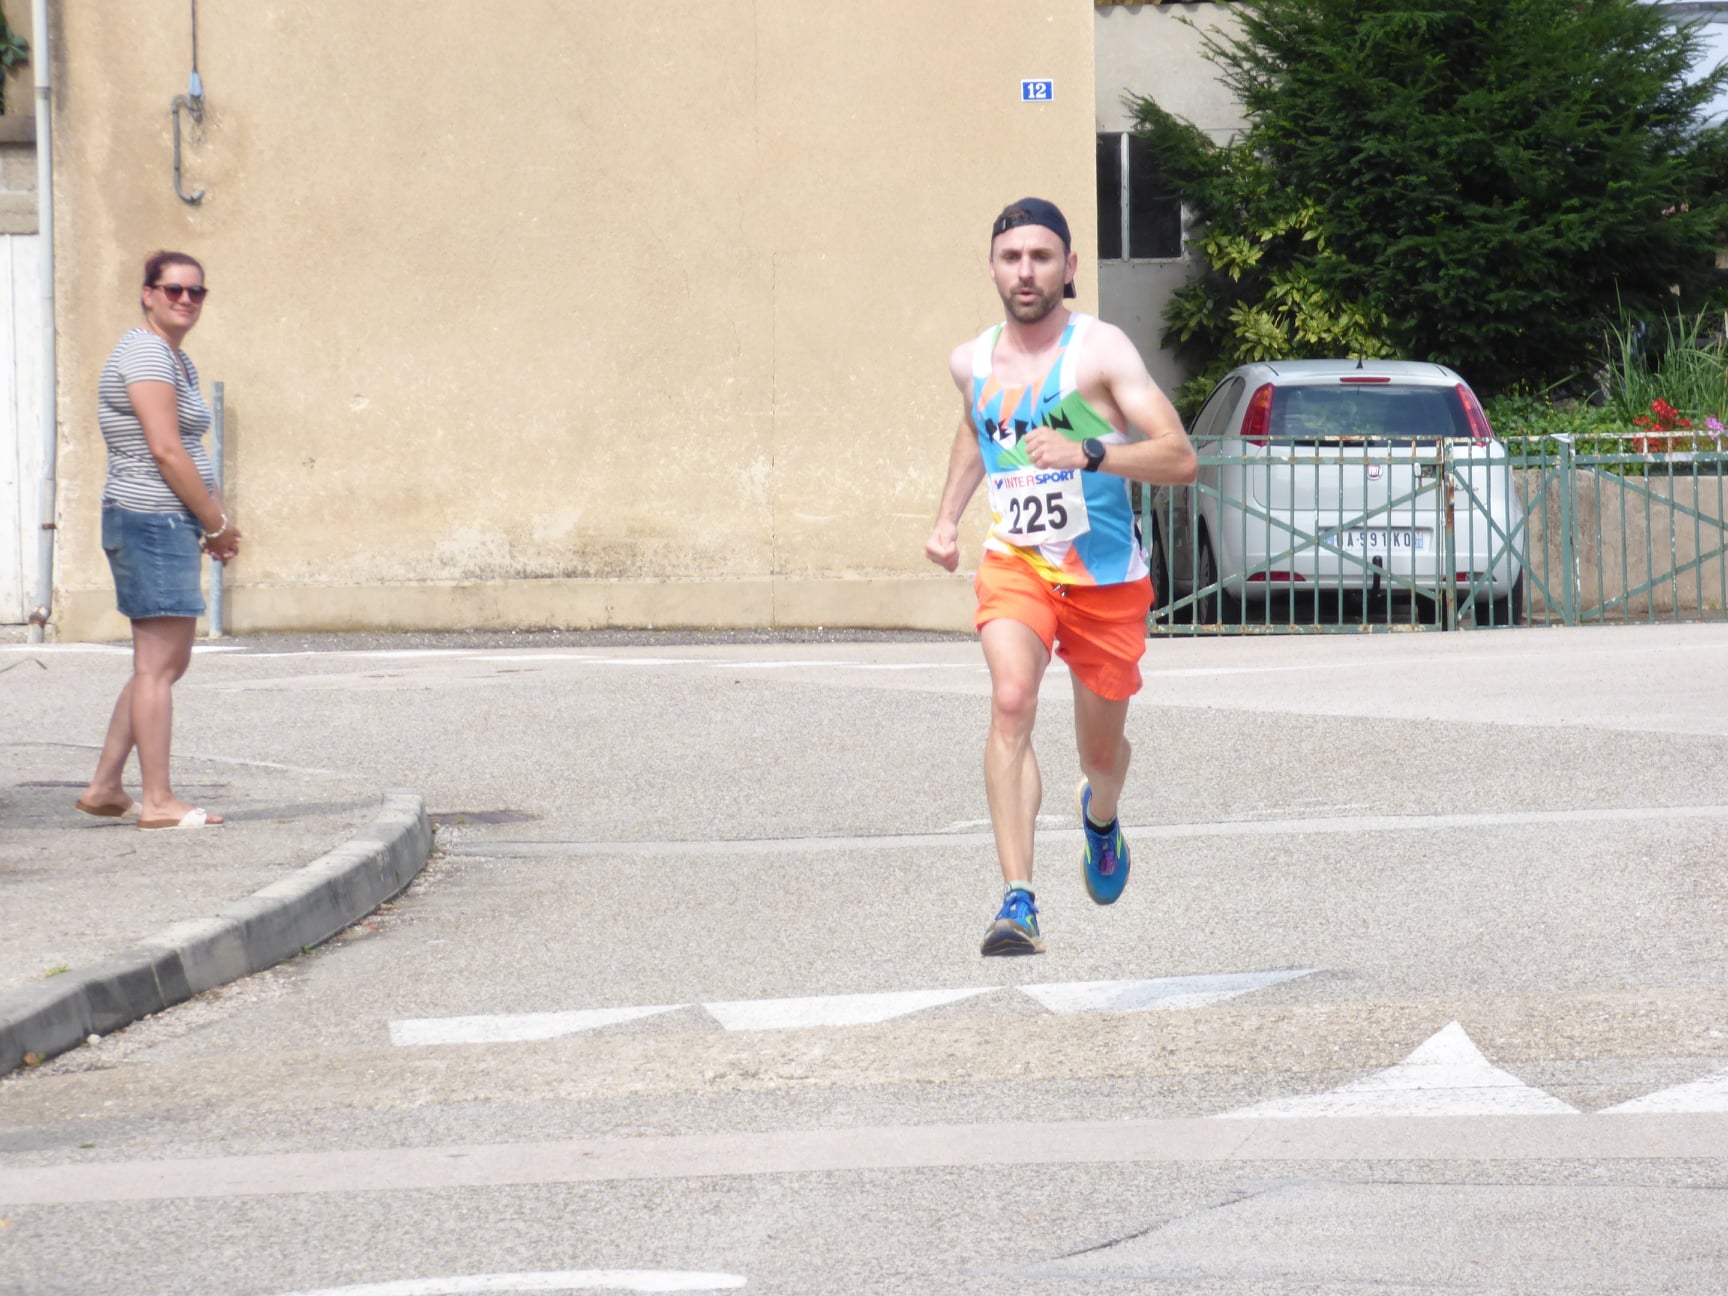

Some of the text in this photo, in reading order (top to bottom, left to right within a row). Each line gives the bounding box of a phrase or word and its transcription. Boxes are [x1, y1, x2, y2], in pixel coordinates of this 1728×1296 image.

[1027, 82, 1047, 99] 12
[1004, 470, 1074, 488] INTERSPORT
[1008, 492, 1067, 534] 225
